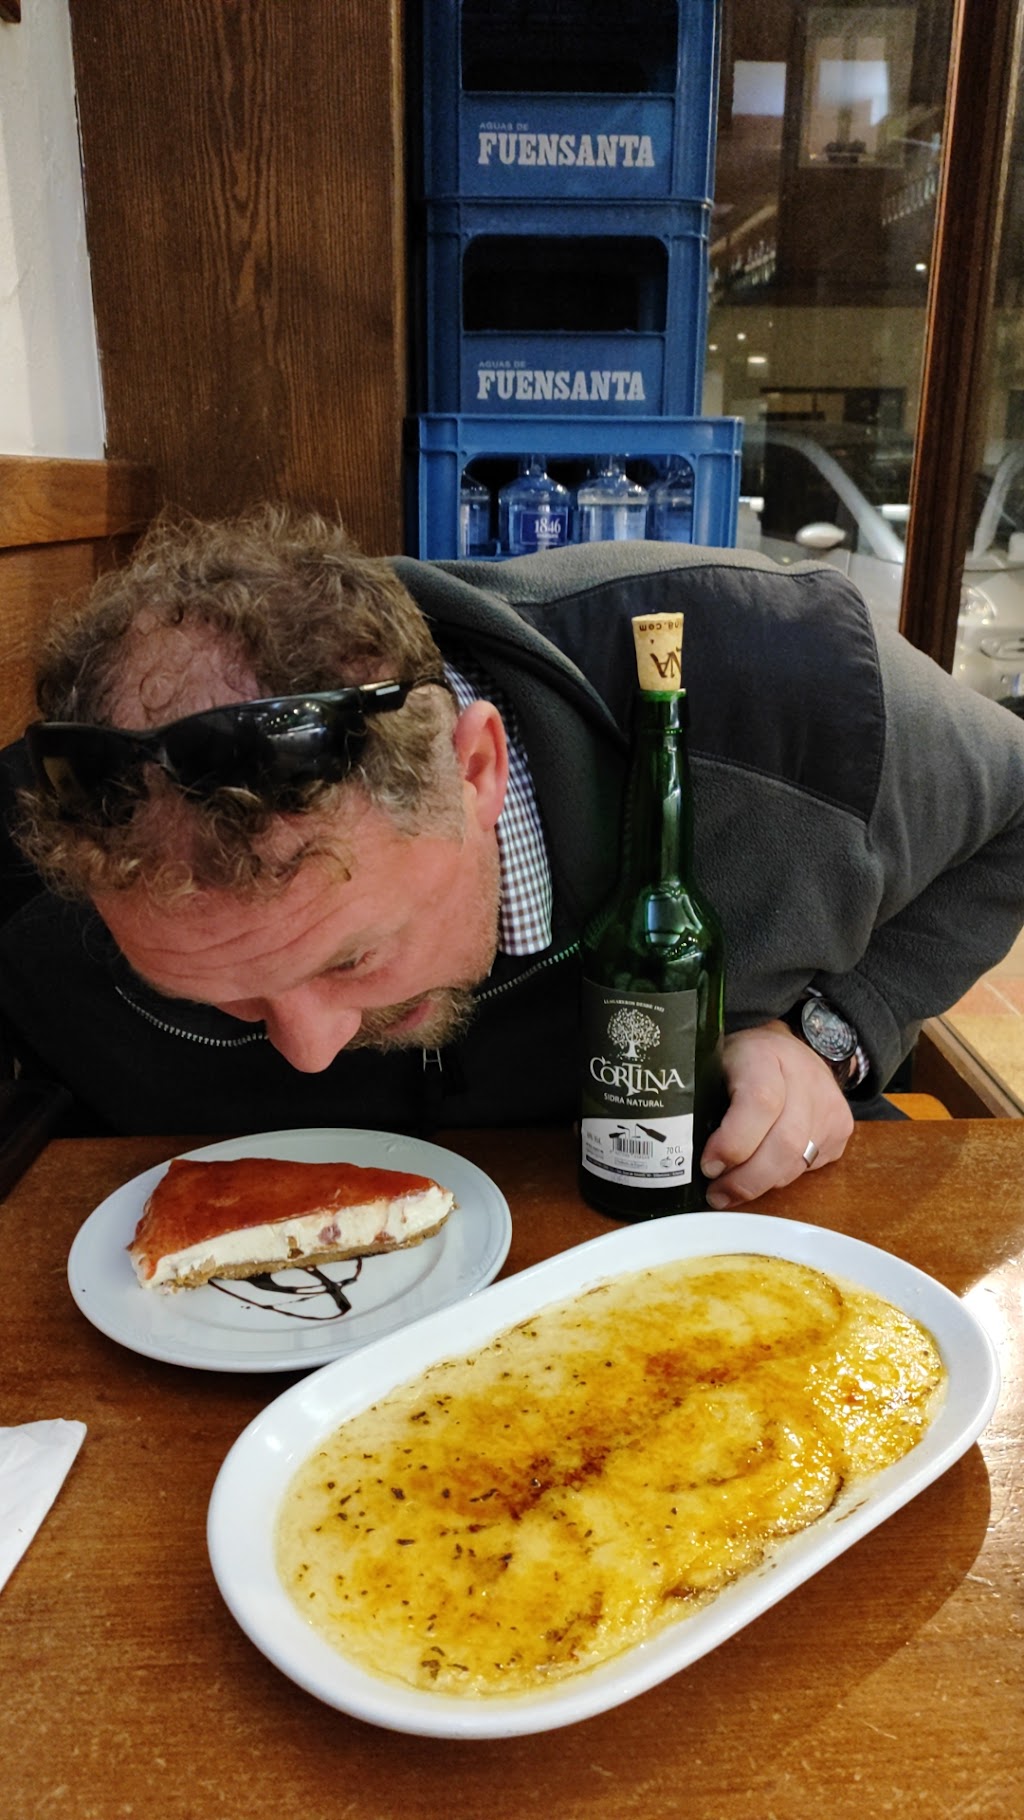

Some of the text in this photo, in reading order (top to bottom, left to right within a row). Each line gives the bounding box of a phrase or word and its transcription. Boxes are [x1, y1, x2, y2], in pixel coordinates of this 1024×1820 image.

[479, 122, 529, 131] AGUAS DE
[478, 132, 655, 167] FUENSANTA
[478, 361, 526, 369] AGUAS DE
[477, 370, 646, 401] FUENSANTA
[534, 517, 561, 534] 1846
[603, 1092, 665, 1108] SIDRA NATURAL
